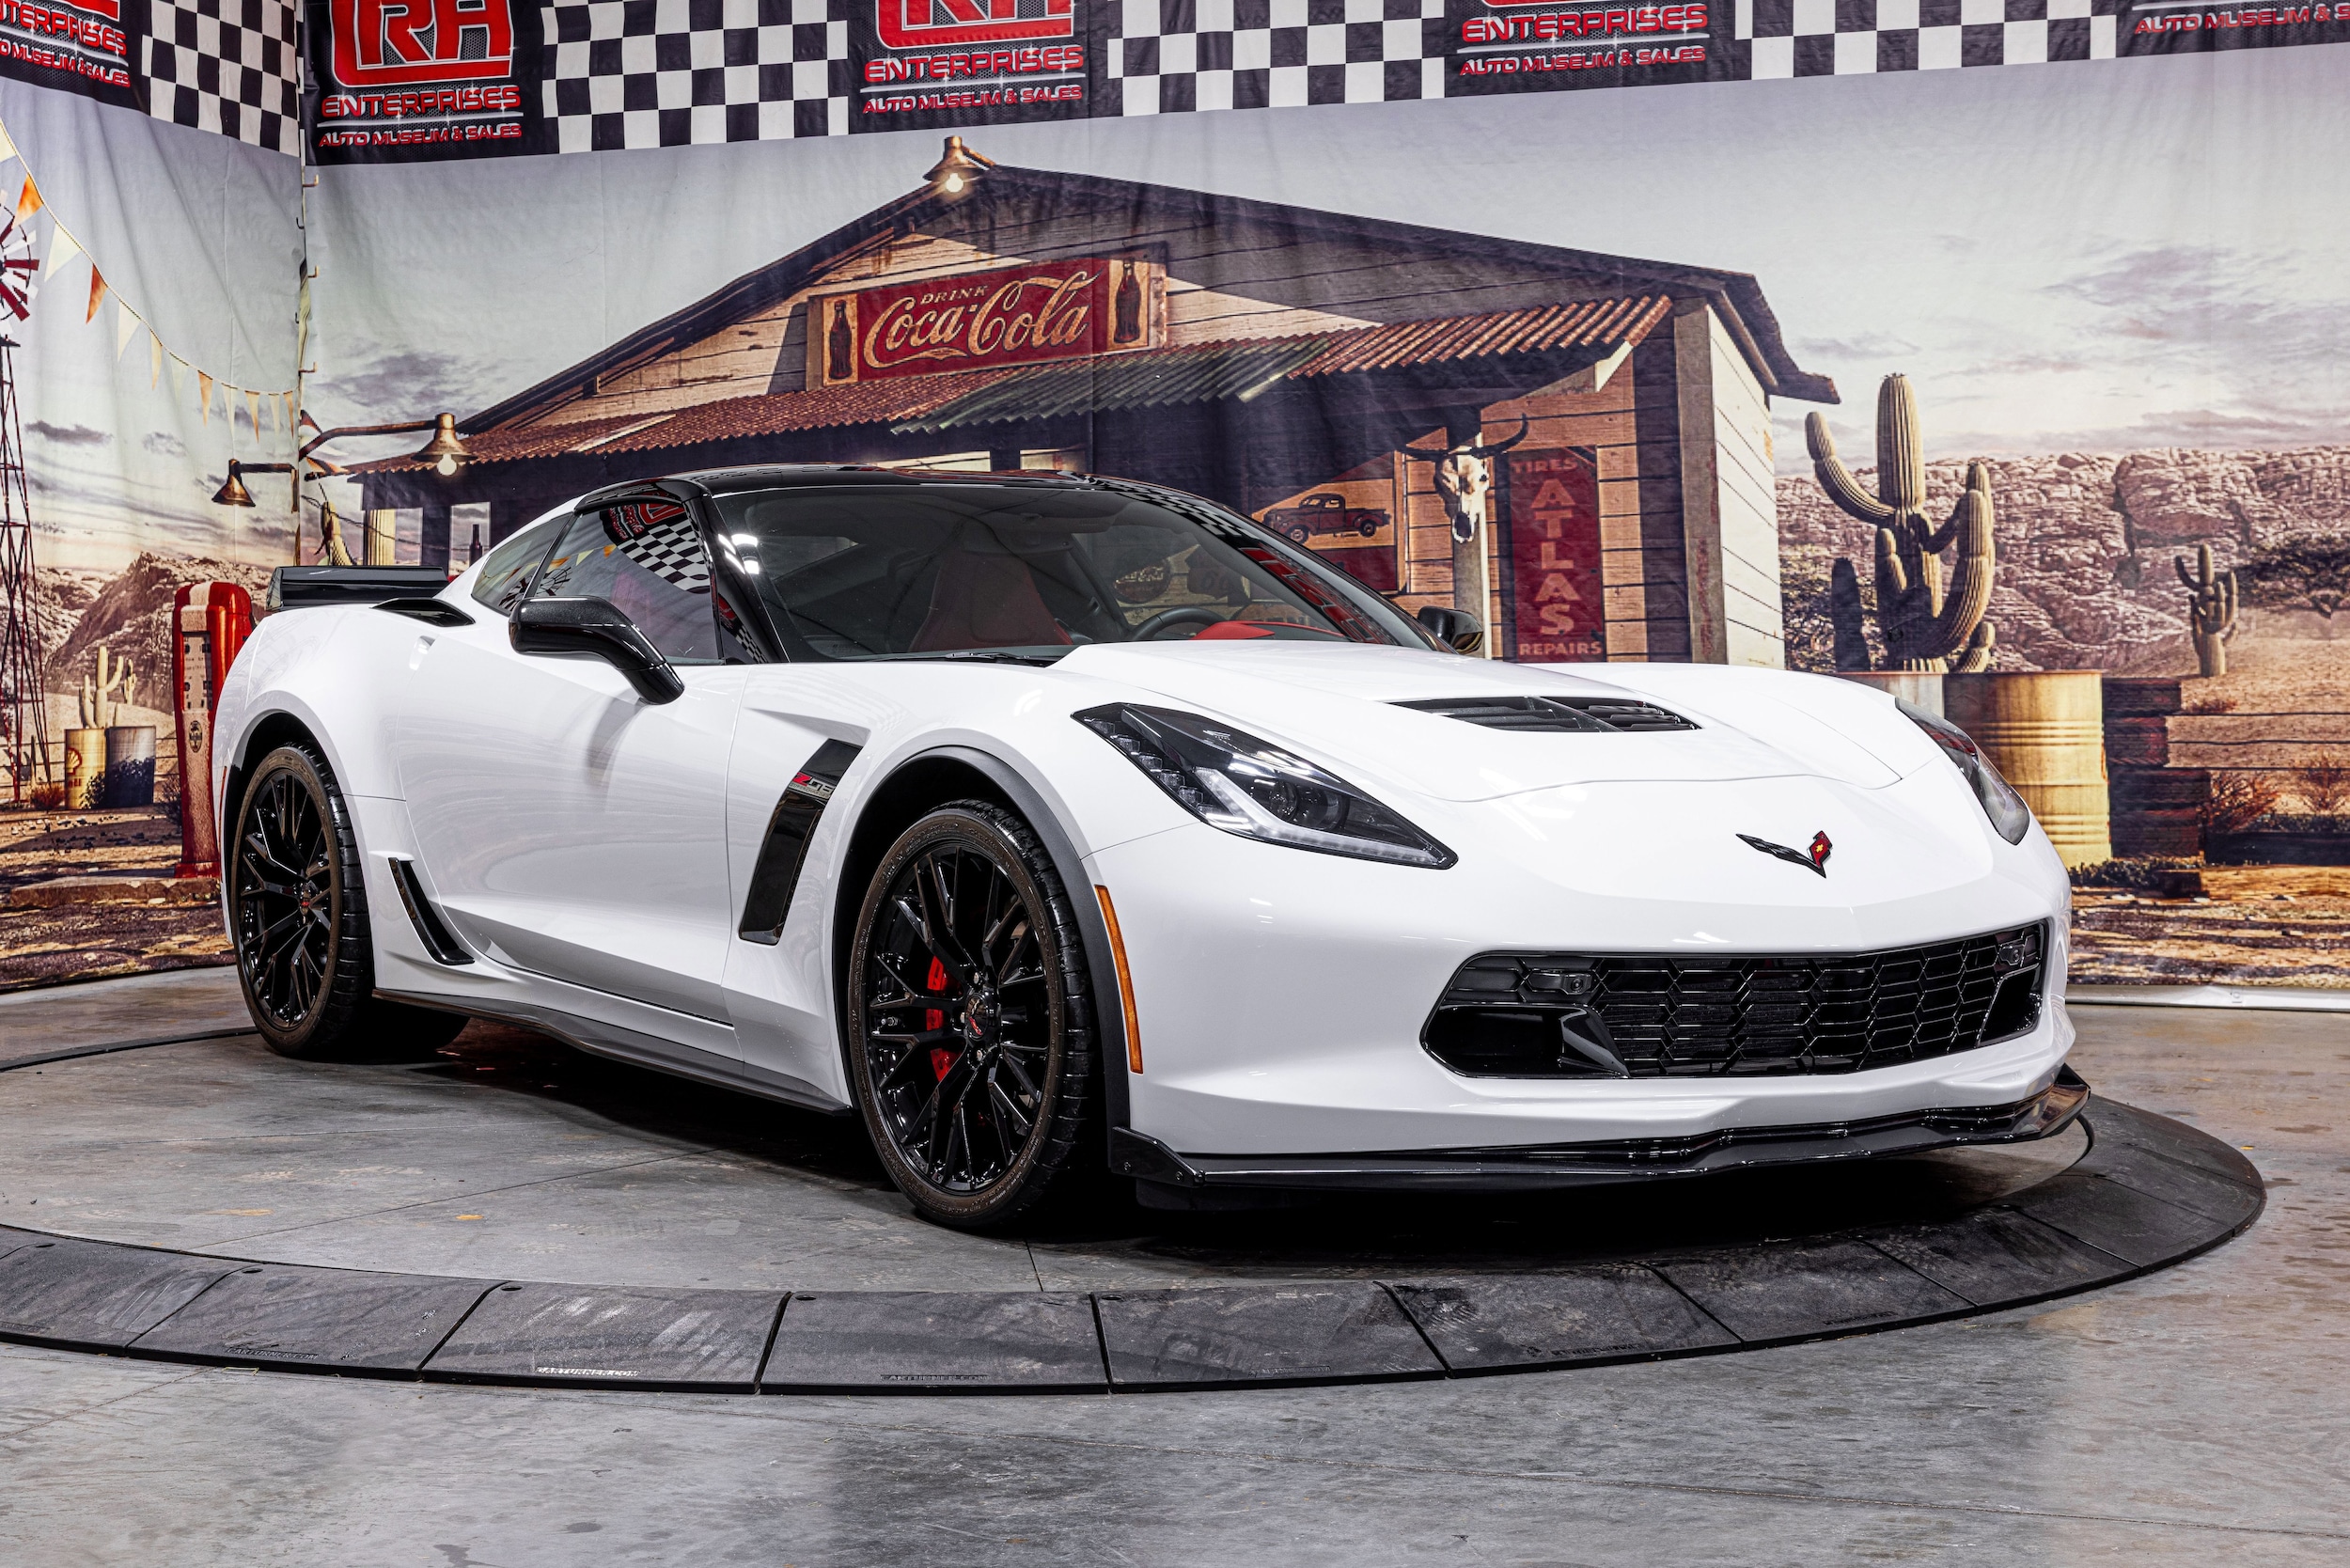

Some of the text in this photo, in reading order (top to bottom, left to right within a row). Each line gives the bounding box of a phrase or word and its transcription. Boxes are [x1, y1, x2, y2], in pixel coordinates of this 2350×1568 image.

[1462, 3, 1709, 42] ENTERPRISES
[2134, 13, 2201, 34] AUTO
[2205, 6, 2310, 29] MUSEUM
[2313, 3, 2330, 22] &
[12, 42, 76, 72] MUSEUM
[78, 56, 87, 75] &
[86, 60, 131, 88] SALES
[865, 45, 1084, 82] ENTERPRISES
[1459, 45, 1706, 76] AUTO MUSEUM & SALES
[321, 85, 522, 118] ENTERPRISES
[862, 85, 1083, 114] AUTO MUSEUM & SALES
[318, 122, 522, 148] AUTO MUSEUM & SALES
[919, 284, 989, 306] DRINK
[864, 270, 1103, 369] Coca-Cola
[1510, 458, 1578, 474] TIRES
[1530, 478, 1582, 635] ATLAS
[1519, 641, 1603, 656] REPAIRS
